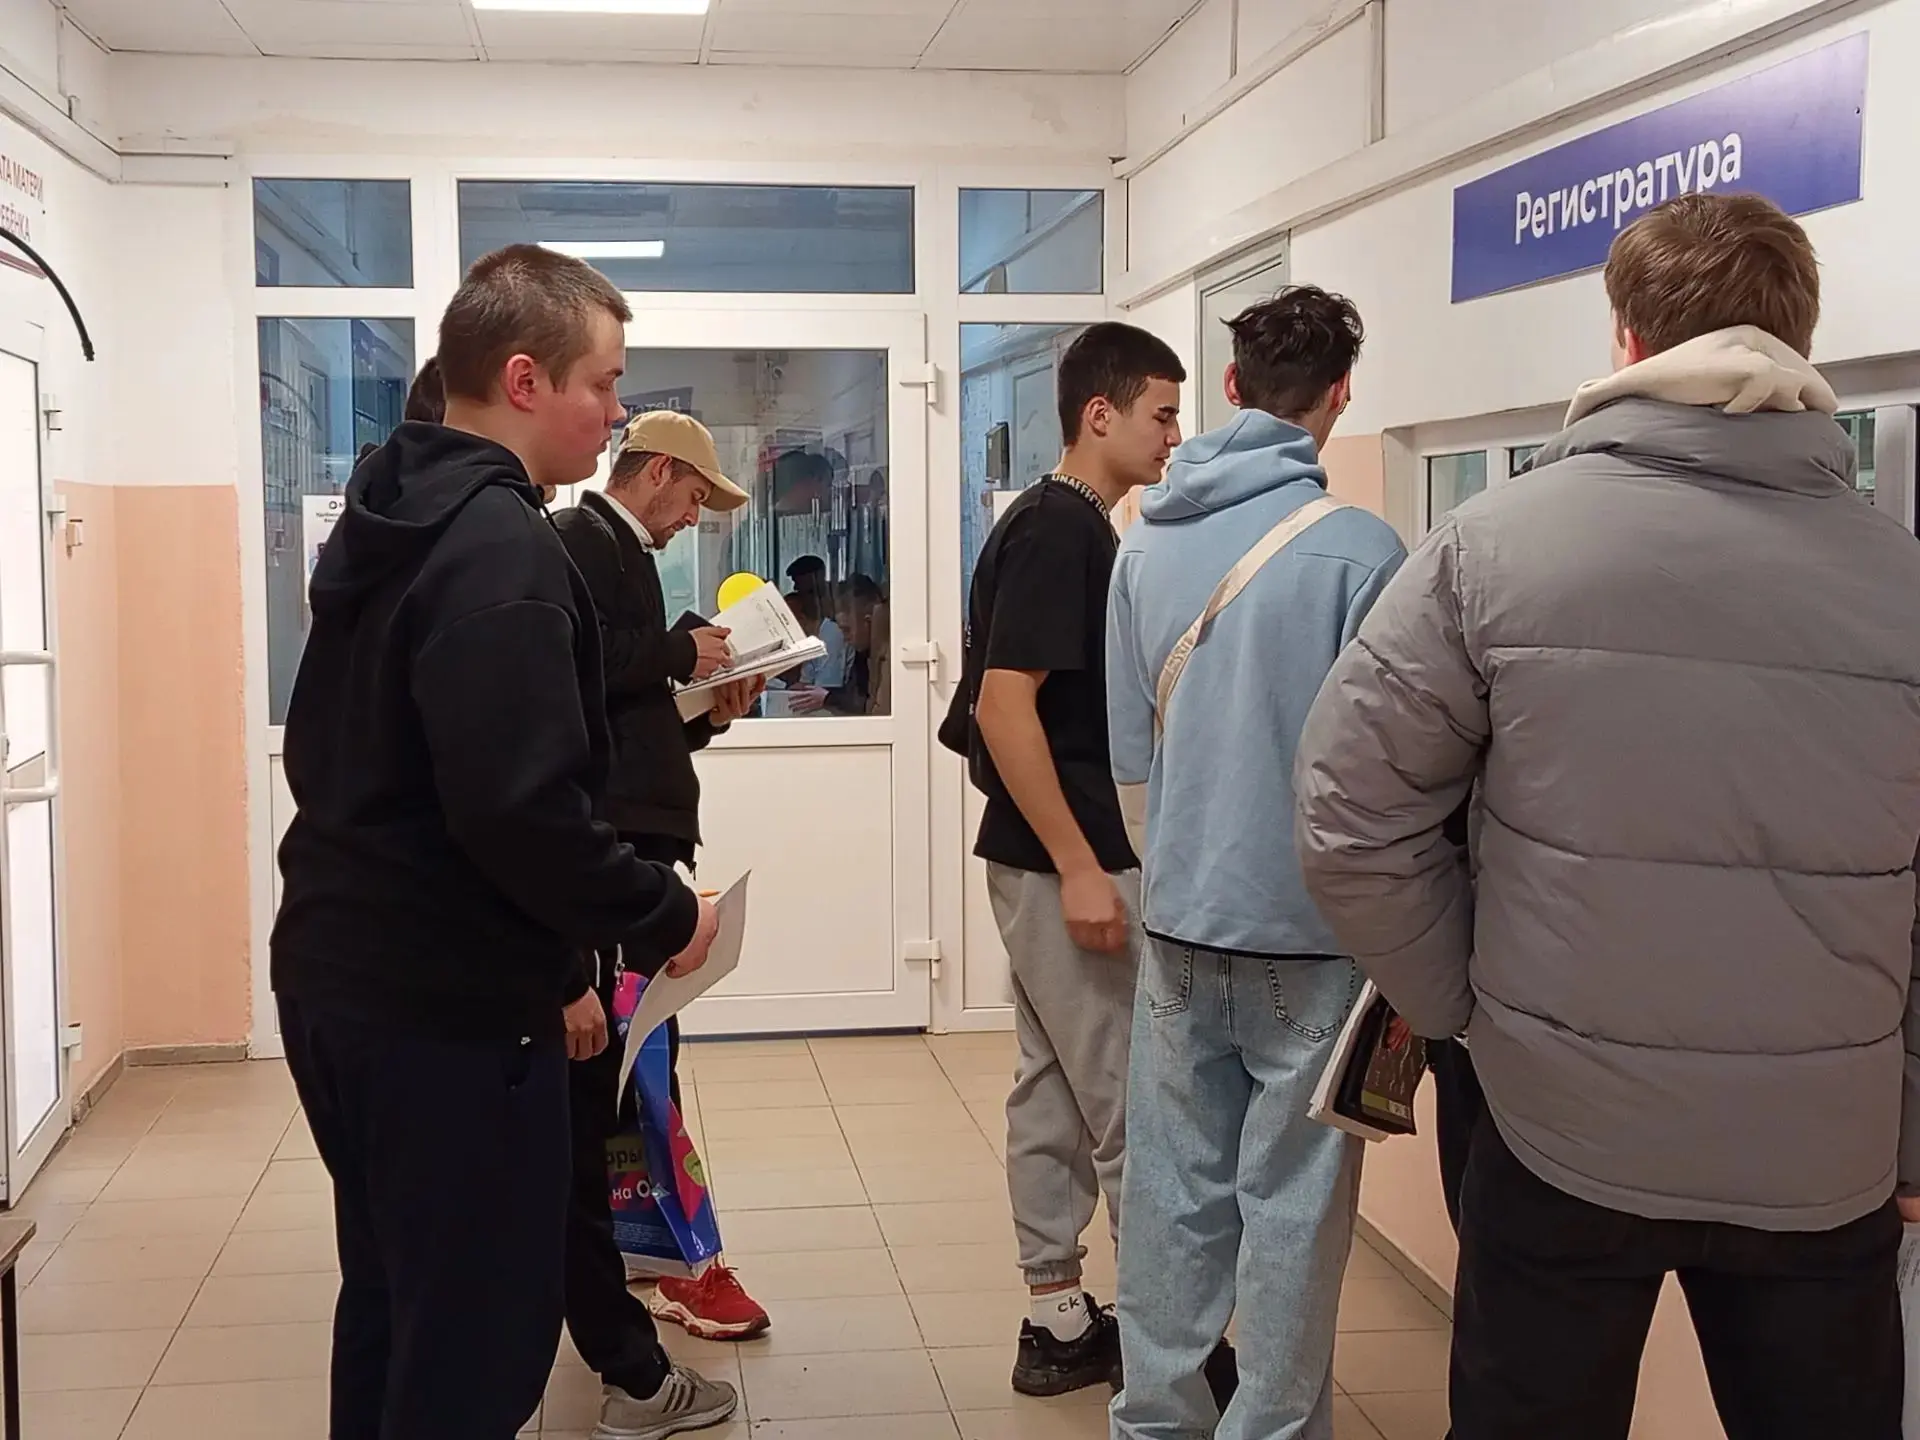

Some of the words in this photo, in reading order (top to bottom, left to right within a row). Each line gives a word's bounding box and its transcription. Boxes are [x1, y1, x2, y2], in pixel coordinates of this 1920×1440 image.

[13, 160, 44, 204] МАТЕРИ
[1514, 132, 1742, 244] Регистратура
[0, 202, 31, 242] ЕБЁНКА
[612, 1187, 633, 1200] на
